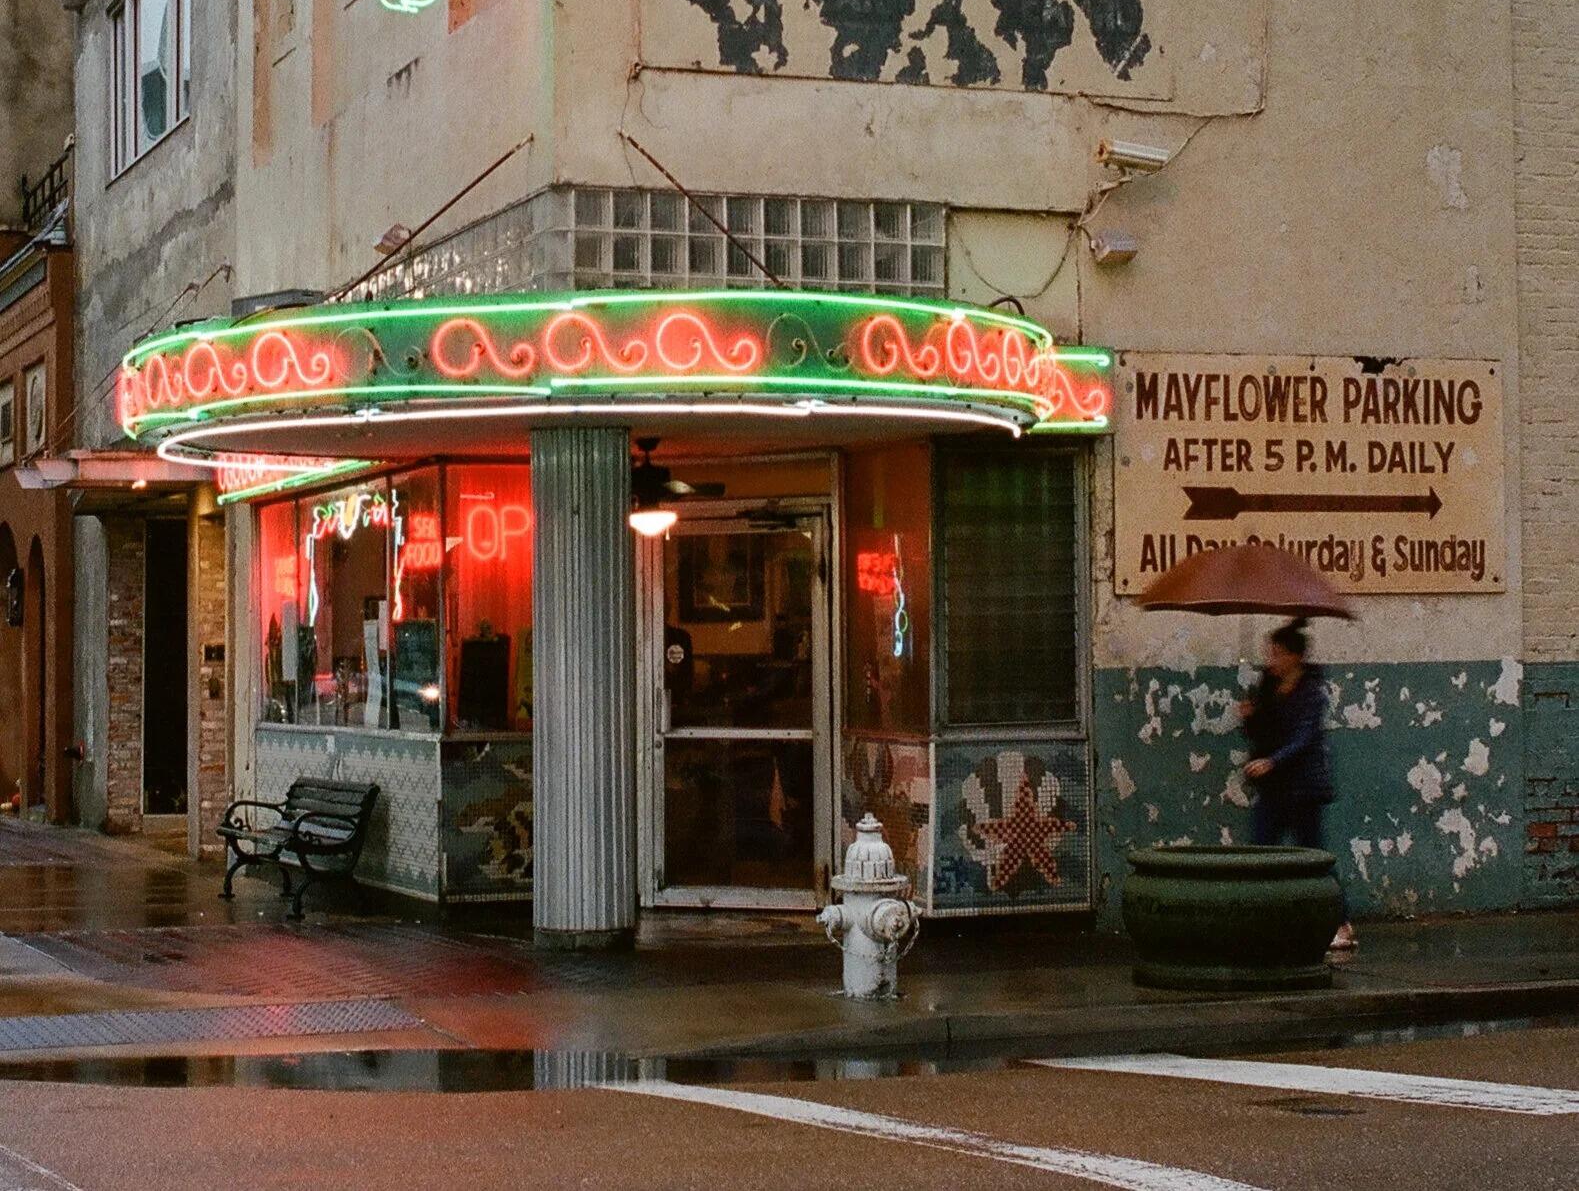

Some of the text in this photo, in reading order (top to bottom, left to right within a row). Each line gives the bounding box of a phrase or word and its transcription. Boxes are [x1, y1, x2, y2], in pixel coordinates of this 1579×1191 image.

[1135, 371, 1483, 426] MAYFLOWER PARKING
[1162, 437, 1254, 473] AFTER
[1264, 439, 1285, 472] 5
[1367, 441, 1456, 475] DAILY
[467, 505, 532, 560] OP
[1139, 533, 1177, 573] All
[1370, 536, 1387, 578] &
[1392, 534, 1486, 582] Sunday
